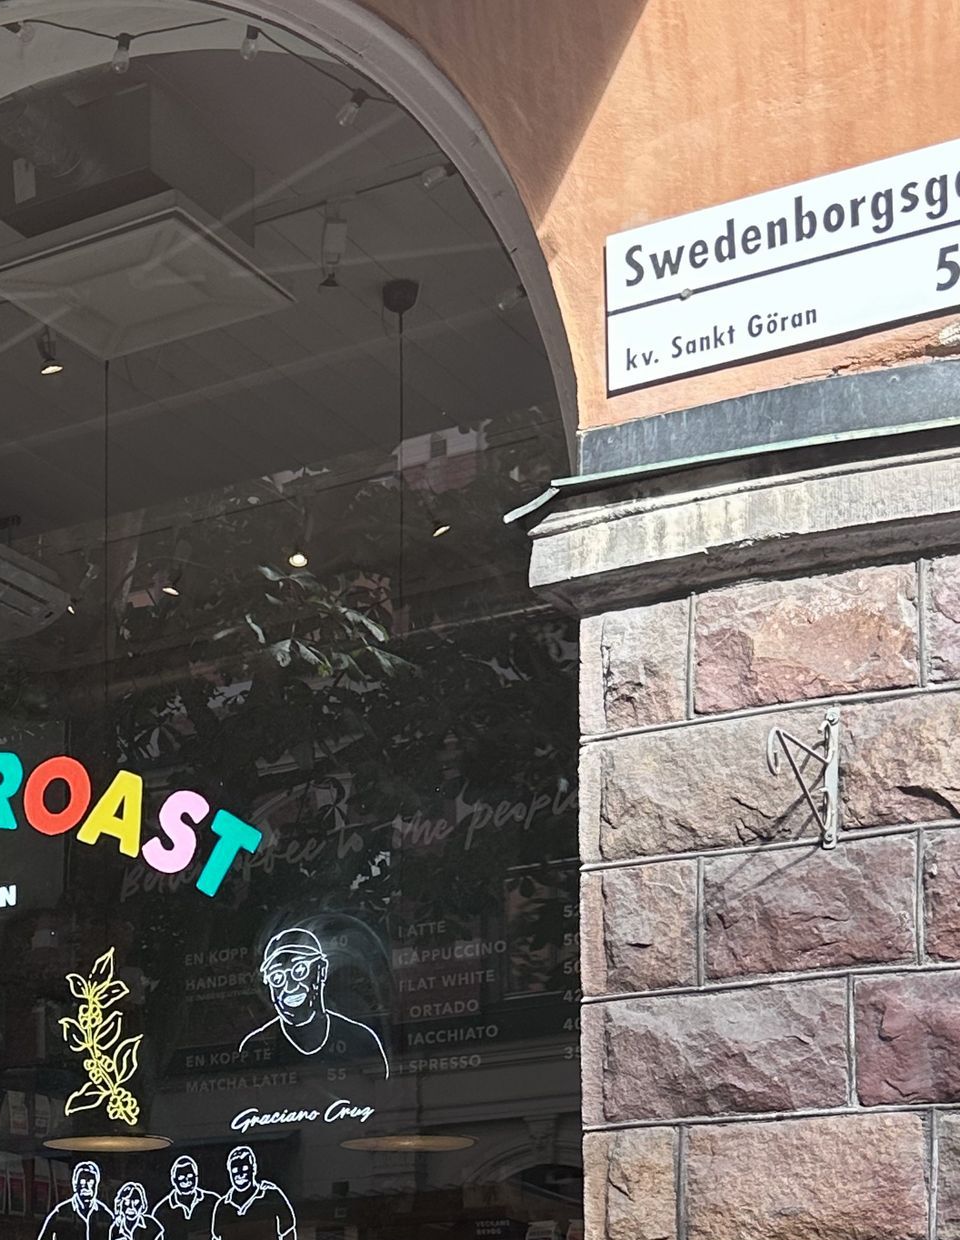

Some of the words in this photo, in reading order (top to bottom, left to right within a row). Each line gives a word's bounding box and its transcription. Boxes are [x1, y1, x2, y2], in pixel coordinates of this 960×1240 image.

[625, 170, 960, 287] Swedenborgsg
[626, 348, 660, 371] kv.
[672, 325, 735, 358] Sankt
[748, 307, 817, 338] Göran
[185, 953, 207, 967] EN
[209, 947, 249, 963] KOPP
[185, 971, 258, 991] HANDBRY
[442, 970, 496, 988] WHITE
[409, 999, 480, 1018] ORTADO
[186, 1056, 205, 1068] EN
[210, 1051, 249, 1065] KOPP
[399, 1054, 482, 1074] SPRESSO
[186, 1076, 248, 1093] MATCHA
[253, 1071, 298, 1088] LATTE
[327, 1068, 347, 1081] 55
[230, 1107, 320, 1134] Graciano
[323, 1100, 376, 1122] Cruz
